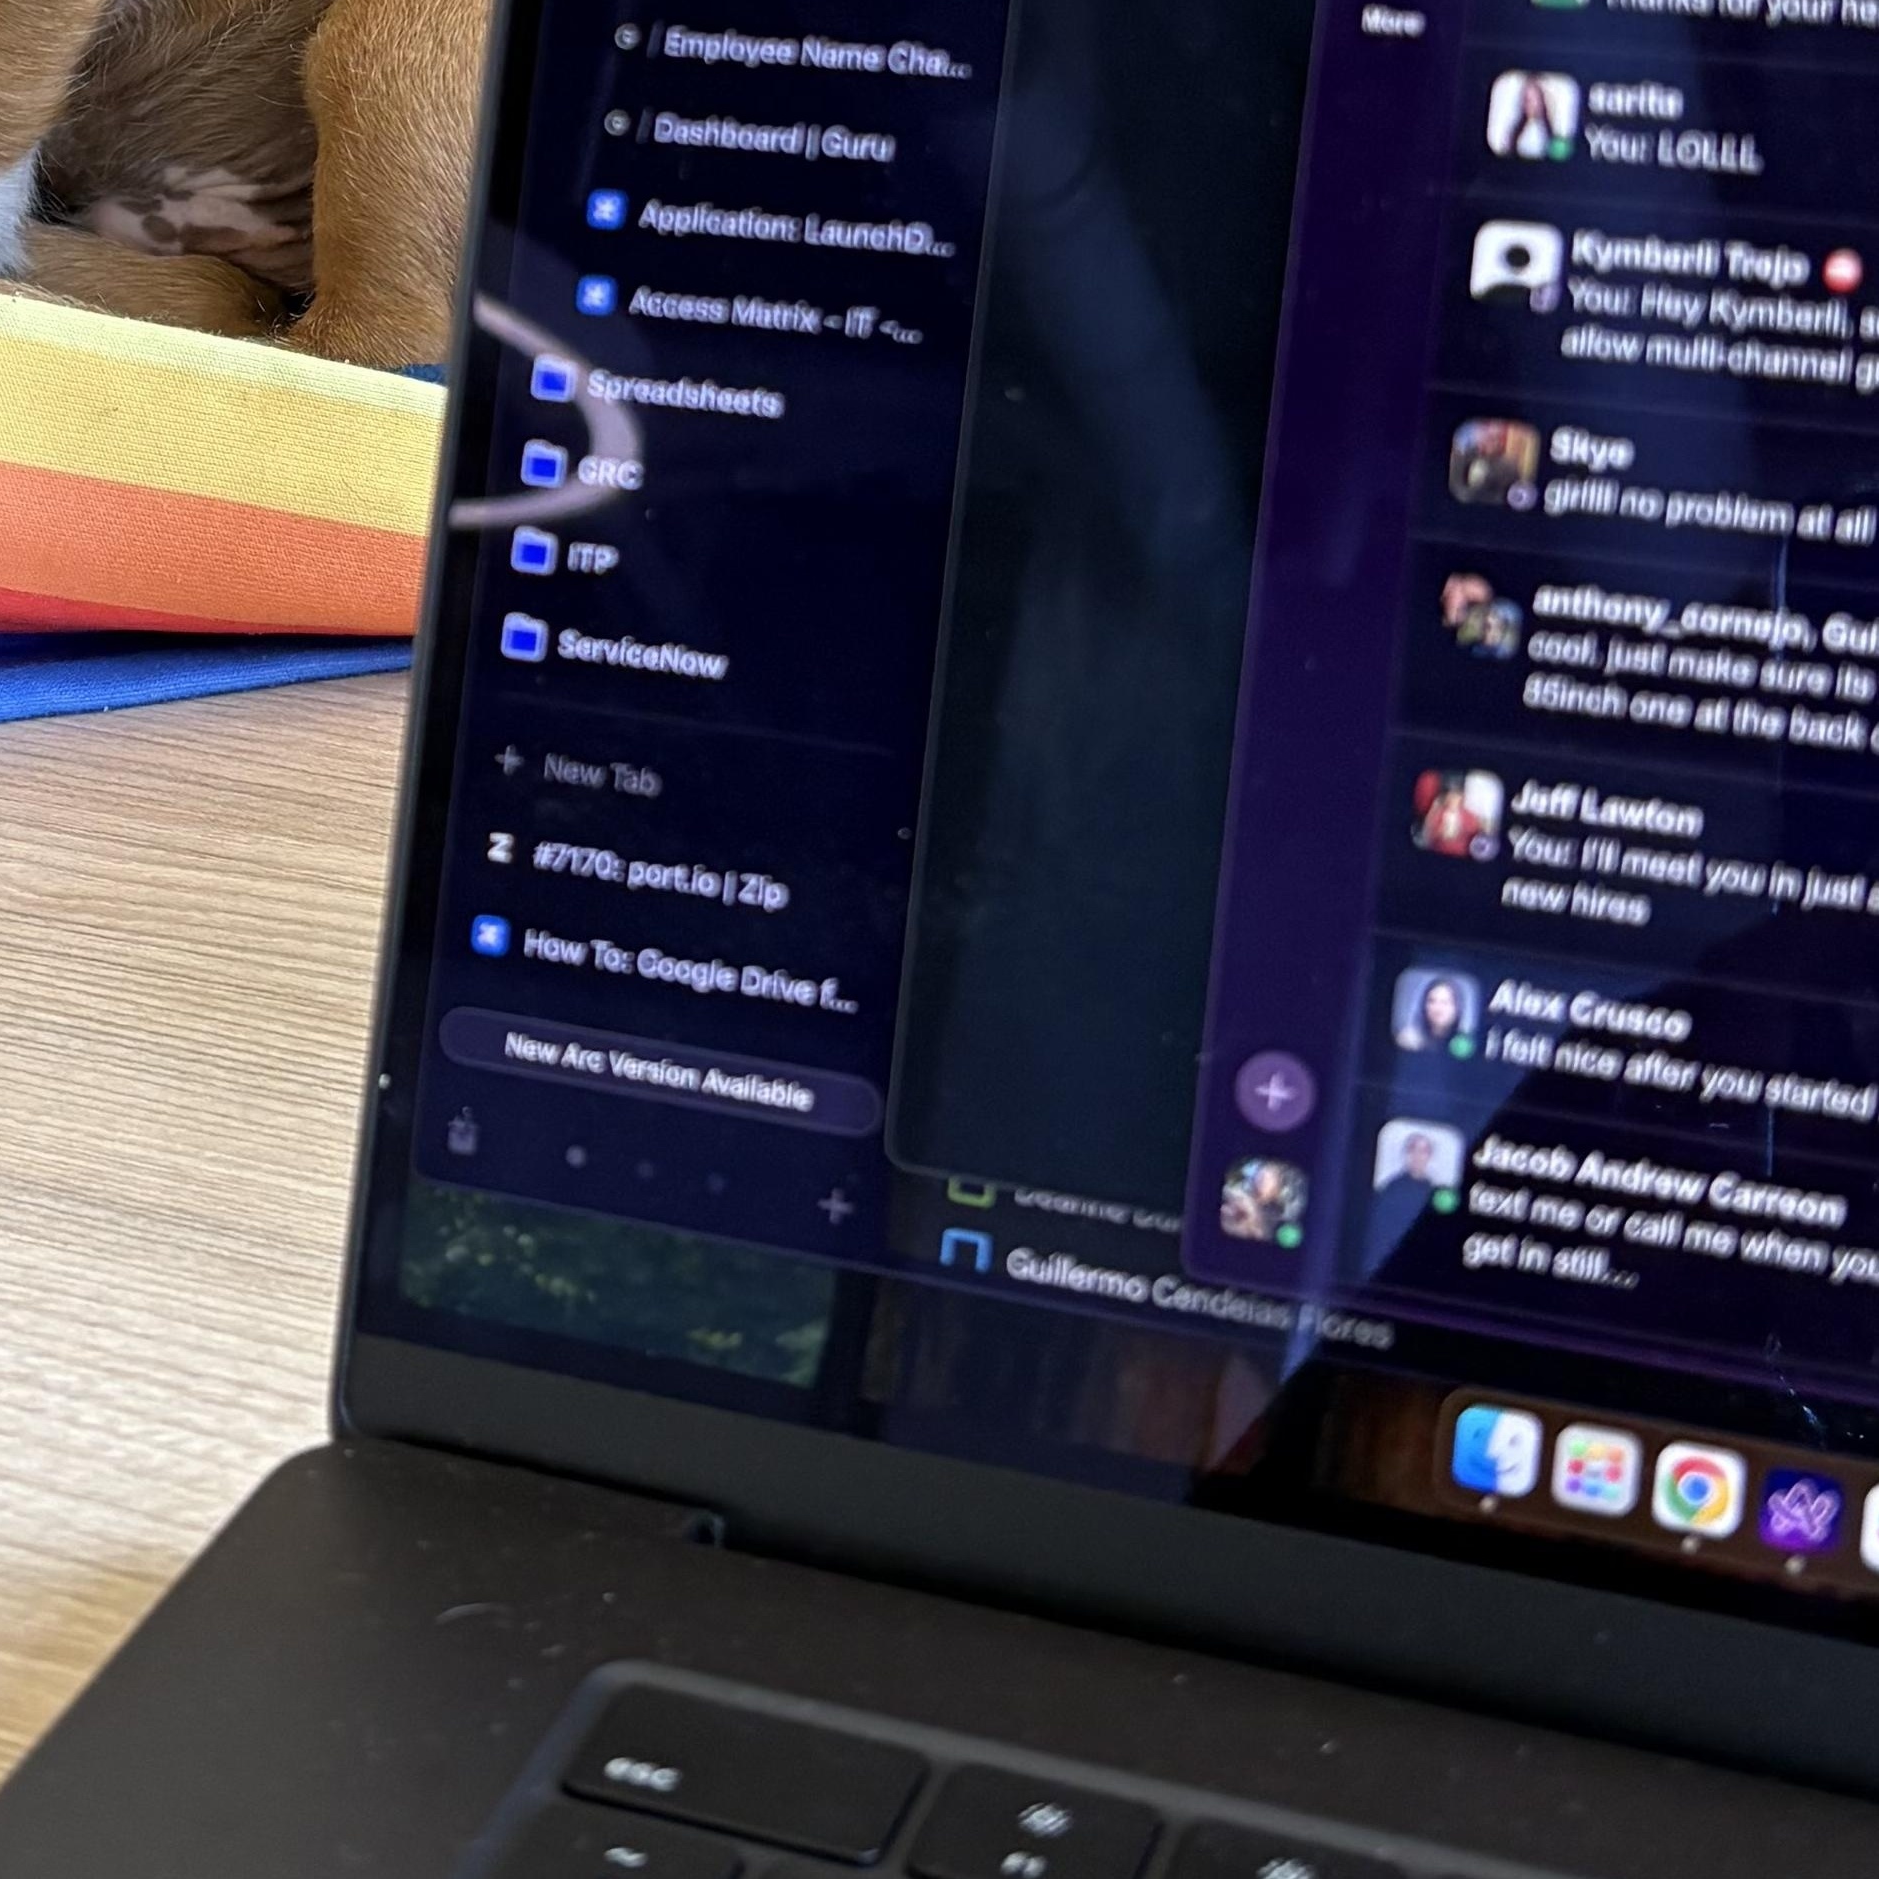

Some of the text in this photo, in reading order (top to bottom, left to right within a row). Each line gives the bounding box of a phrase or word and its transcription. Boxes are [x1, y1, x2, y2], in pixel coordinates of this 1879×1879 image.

[1361, 3, 1426, 37] More
[664, 24, 800, 68] Employee
[800, 34, 889, 73] Name
[654, 111, 806, 155] Dashboard
[821, 124, 896, 163] Guru
[1584, 123, 1656, 164] You:
[639, 198, 956, 258] Application: LaunchD...
[629, 285, 730, 324] Access
[731, 295, 823, 335] Matrix
[845, 305, 881, 339] IT
[1567, 274, 1639, 317] You:
[1641, 281, 1708, 330] Hey
[1560, 322, 1646, 363] allow
[1645, 332, 1854, 386] multi-channel
[586, 368, 786, 419] Spreadsheets
[578, 453, 645, 491] GRC
[1619, 486, 1665, 521] no
[1664, 488, 1796, 536] problem
[1796, 503, 1834, 542] at
[1834, 504, 1877, 547] all
[566, 540, 620, 575] ITP
[558, 628, 730, 681] ServiceNow
[1604, 633, 1668, 678] just
[1667, 646, 1759, 690] make
[1759, 660, 1834, 700] sure
[1629, 690, 1694, 730] one
[1693, 696, 1732, 735] at
[1732, 697, 1788, 742] the
[1789, 704, 1870, 753] back
[543, 752, 664, 799] New Tab
[1511, 779, 1704, 840] Jeff Lawton
[533, 840, 626, 882] #7170:
[626, 860, 722, 899] port.io
[737, 872, 791, 913] Zip
[1508, 825, 1578, 867] You:
[1580, 834, 1622, 874] I'll
[1621, 845, 1704, 889] meet
[1703, 857, 1768, 897] you
[1769, 860, 1804, 902] in
[1801, 865, 1868, 913] just
[1501, 876, 1652, 926] new hires
[524, 927, 589, 967] How
[589, 939, 635, 974] To:
[636, 948, 740, 994] Google
[739, 965, 820, 1007] Drive
[1488, 978, 1568, 1024] Alex
[504, 1031, 815, 1113] New Arc Version Available
[1553, 1040, 1624, 1081] nice
[1623, 1049, 1702, 1093] after
[1699, 1063, 1765, 1105] you
[1763, 1072, 1879, 1124] started
[1472, 1132, 1849, 1231] Jacob Andrew Carreon
[1462, 1231, 1519, 1270] get
[1517, 1234, 1553, 1276] in
[1468, 1180, 1532, 1220] text
[1529, 1194, 1586, 1232] me
[1585, 1203, 1626, 1237] or
[1623, 1210, 1685, 1249] call
[1682, 1221, 1739, 1260] me
[1739, 1227, 1832, 1274] when
[1005, 1246, 1154, 1305] Guillermo
[603, 1756, 681, 1792] esc
